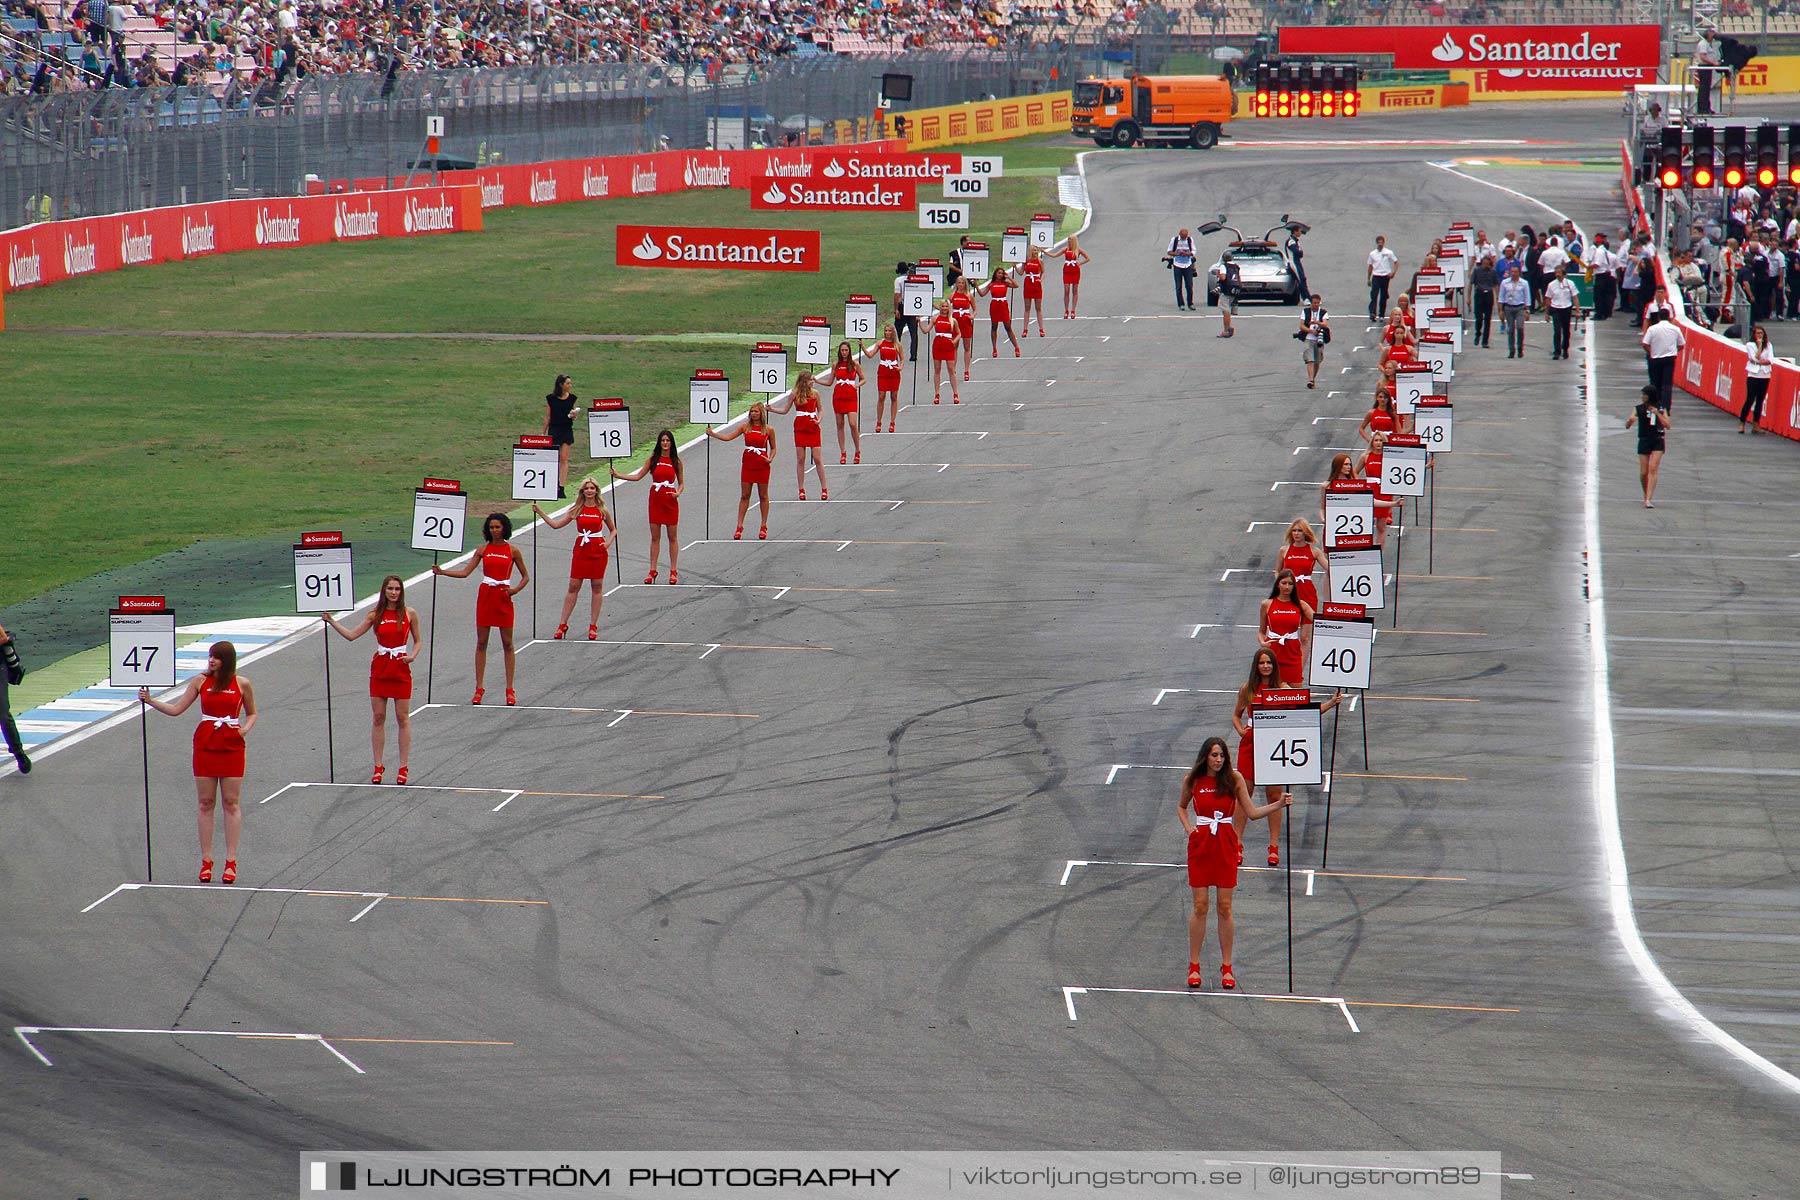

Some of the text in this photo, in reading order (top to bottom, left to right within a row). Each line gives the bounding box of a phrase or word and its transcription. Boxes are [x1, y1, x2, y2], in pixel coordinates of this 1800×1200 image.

[1469, 32, 1621, 62] Santander
[1380, 89, 1435, 107] PIRELLI
[432, 119, 438, 133] 1
[692, 155, 730, 186] Santander
[848, 157, 951, 178] Santander
[971, 161, 991, 173] 50
[790, 183, 903, 207] Santander
[950, 180, 981, 193] 100
[342, 198, 379, 237] Santander
[412, 192, 454, 232] Santander
[927, 209, 961, 224] 150
[263, 204, 300, 243] Santander
[1038, 231, 1046, 242] 6
[666, 235, 806, 264] Santander
[1009, 246, 1017, 257] 4
[969, 261, 981, 273] 11
[1447, 270, 1455, 281] 7
[913, 296, 922, 309] 8
[851, 319, 868, 332] 15
[807, 341, 818, 355] 5
[1426, 359, 1443, 374] 12
[758, 369, 778, 385] 16
[699, 397, 720, 414] 10
[1409, 389, 1420, 405] 2
[599, 429, 621, 447] 18
[1421, 425, 1444, 443] 48
[523, 469, 547, 489] 21
[1389, 466, 1416, 486] 36
[423, 516, 454, 539] 20
[1335, 515, 1364, 535] 23
[305, 574, 342, 598] 911
[1341, 575, 1371, 597] 46
[1332, 607, 1362, 615] Santander
[122, 646, 159, 672] 47
[1321, 648, 1356, 673] 40
[1269, 739, 1309, 767] 45
